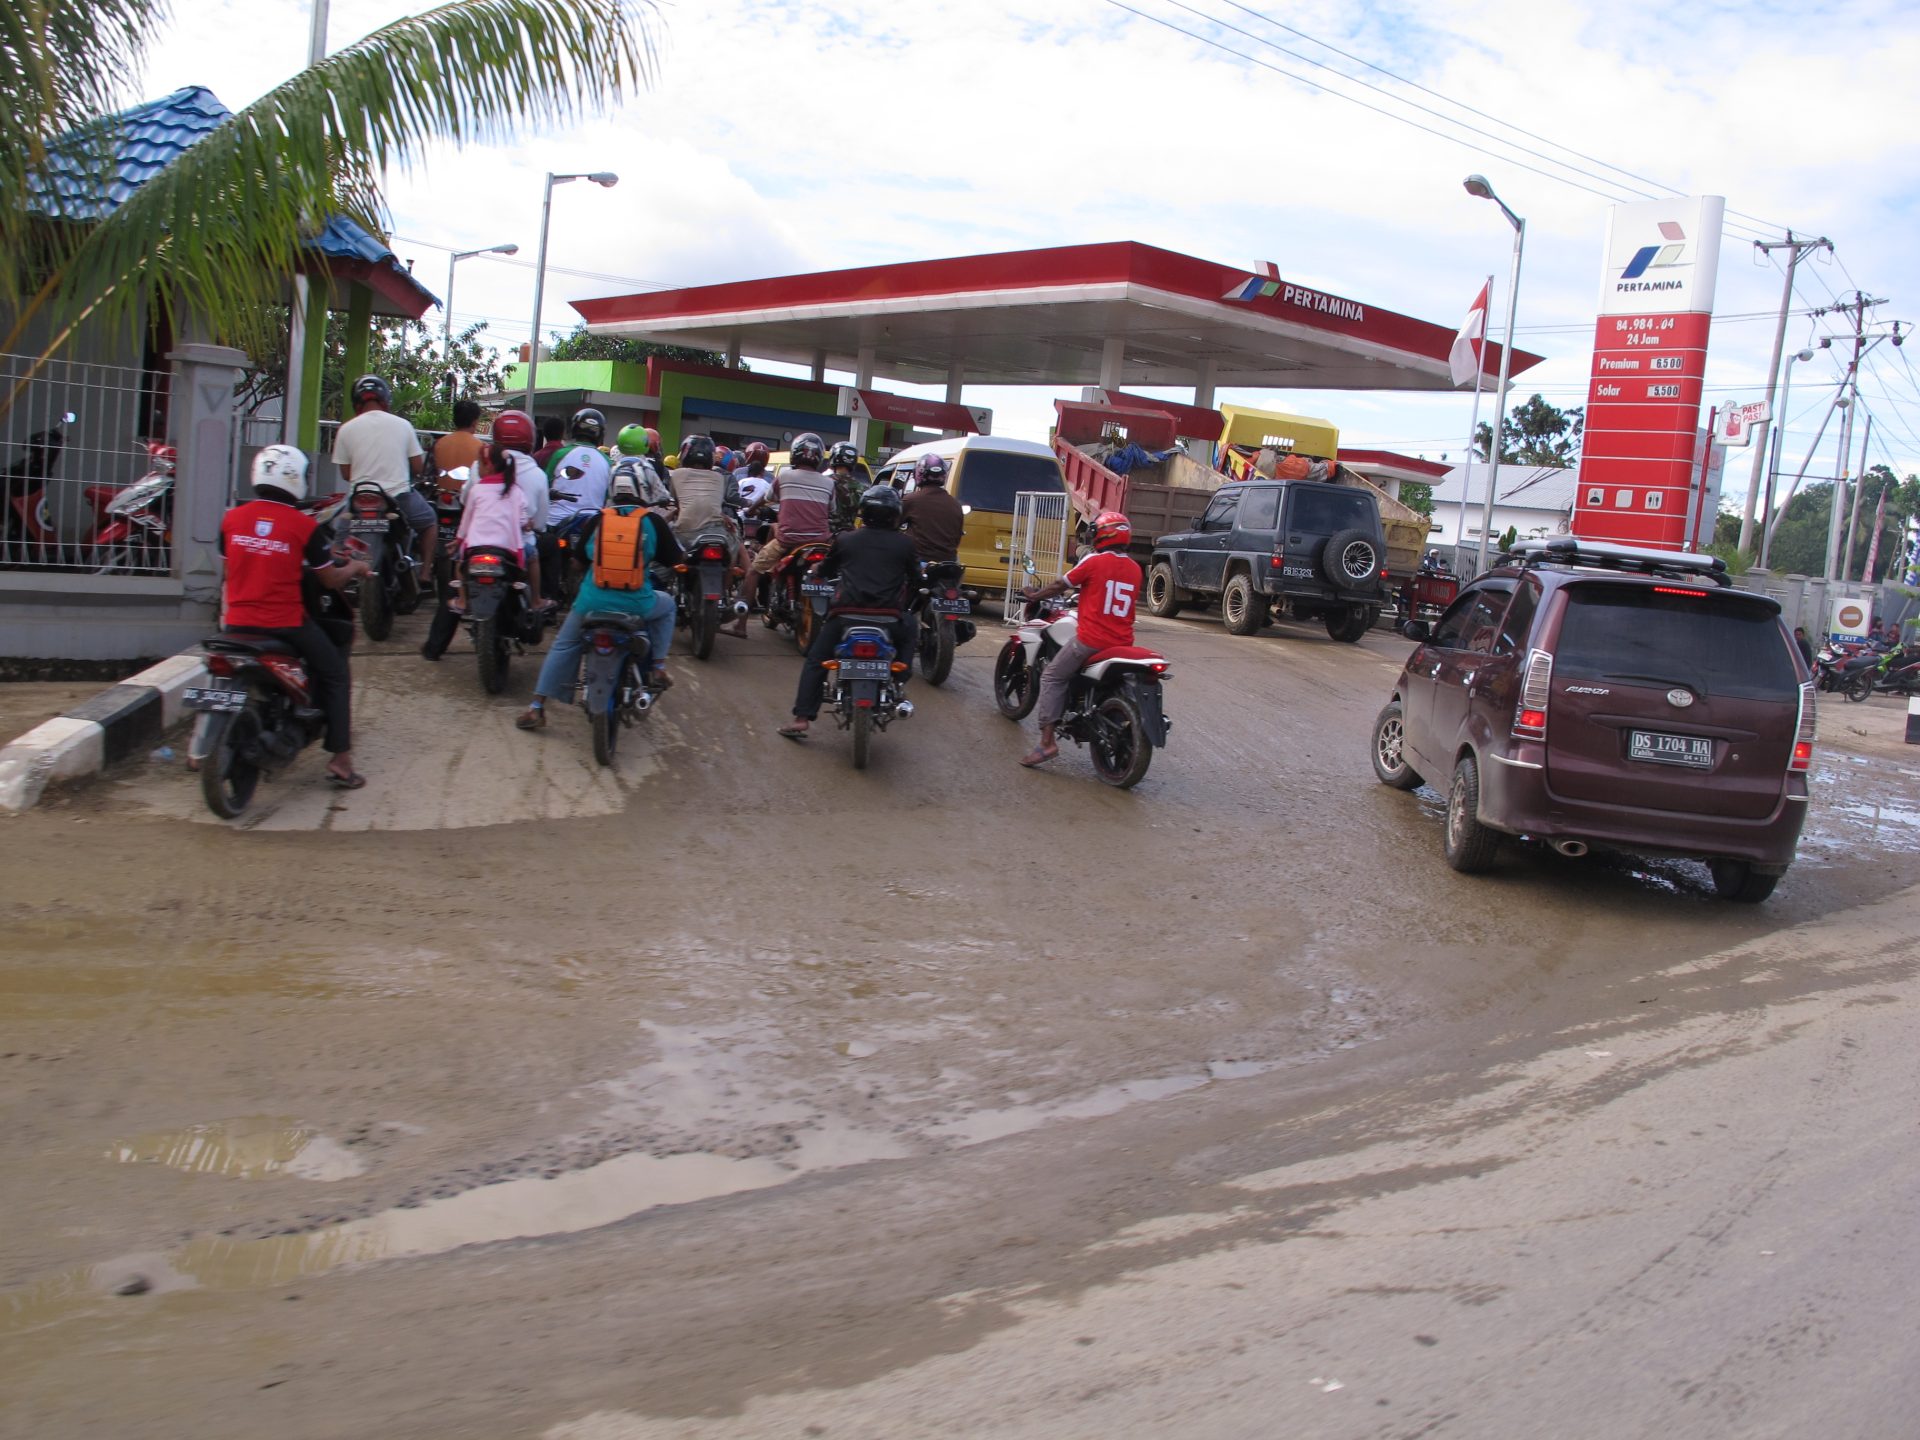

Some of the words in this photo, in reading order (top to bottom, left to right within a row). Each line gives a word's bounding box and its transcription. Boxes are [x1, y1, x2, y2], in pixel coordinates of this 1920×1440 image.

[1616, 280, 1683, 292] PERTAMINA
[1283, 285, 1364, 322] PERTAMINA
[1626, 333, 1639, 346] 24
[1640, 332, 1660, 345] Jam
[1599, 358, 1640, 370] Premium
[1597, 383, 1621, 396] Solar
[851, 397, 859, 411] 3
[1742, 403, 1766, 416] PASTI
[231, 534, 291, 555] PERSIPURA
[1103, 579, 1135, 617] 15
[1838, 634, 1858, 642] EXIT
[1565, 685, 1609, 696] AVANZA
[1635, 734, 1651, 748] DS
[1656, 737, 1687, 752] 1704
[1692, 740, 1708, 754] HA
